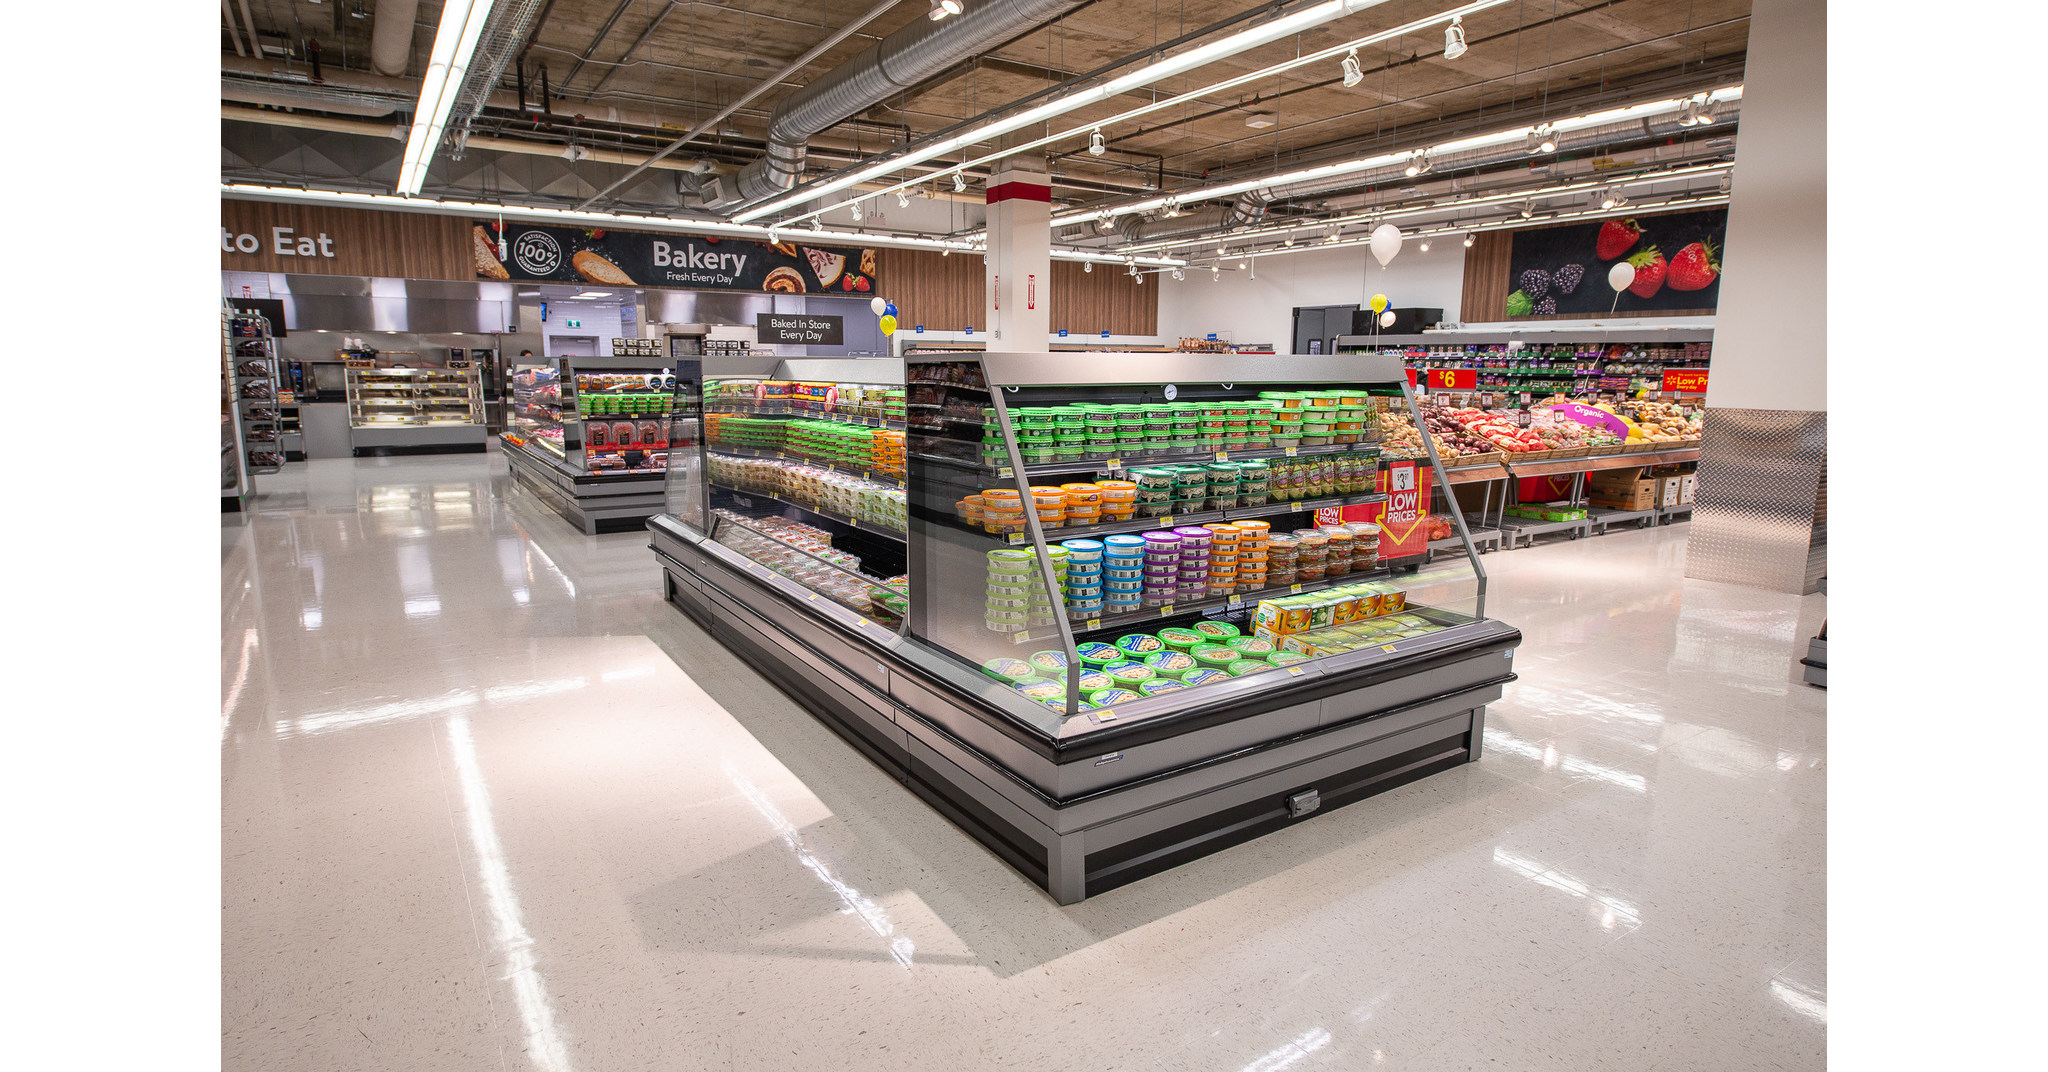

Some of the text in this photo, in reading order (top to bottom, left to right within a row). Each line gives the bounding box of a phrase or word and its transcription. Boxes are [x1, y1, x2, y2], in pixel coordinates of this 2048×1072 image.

[221, 226, 335, 258] to Eat
[523, 233, 558, 253] SATISFACTION
[518, 241, 557, 268] 100%
[653, 240, 748, 277] Bakery
[518, 255, 551, 273] GUARANTEED
[666, 271, 734, 286] Fresh Every Day
[771, 318, 831, 330] Baked In Store
[780, 329, 823, 342] Every Day
[1439, 370, 1456, 388] $6
[1676, 376, 1696, 386] Low
[1574, 405, 1605, 419] Organic
[1388, 491, 1418, 512] LOW
[1319, 515, 1339, 525] PRICES
[1320, 507, 1339, 518] LOW
[1387, 509, 1416, 524] PRICES
